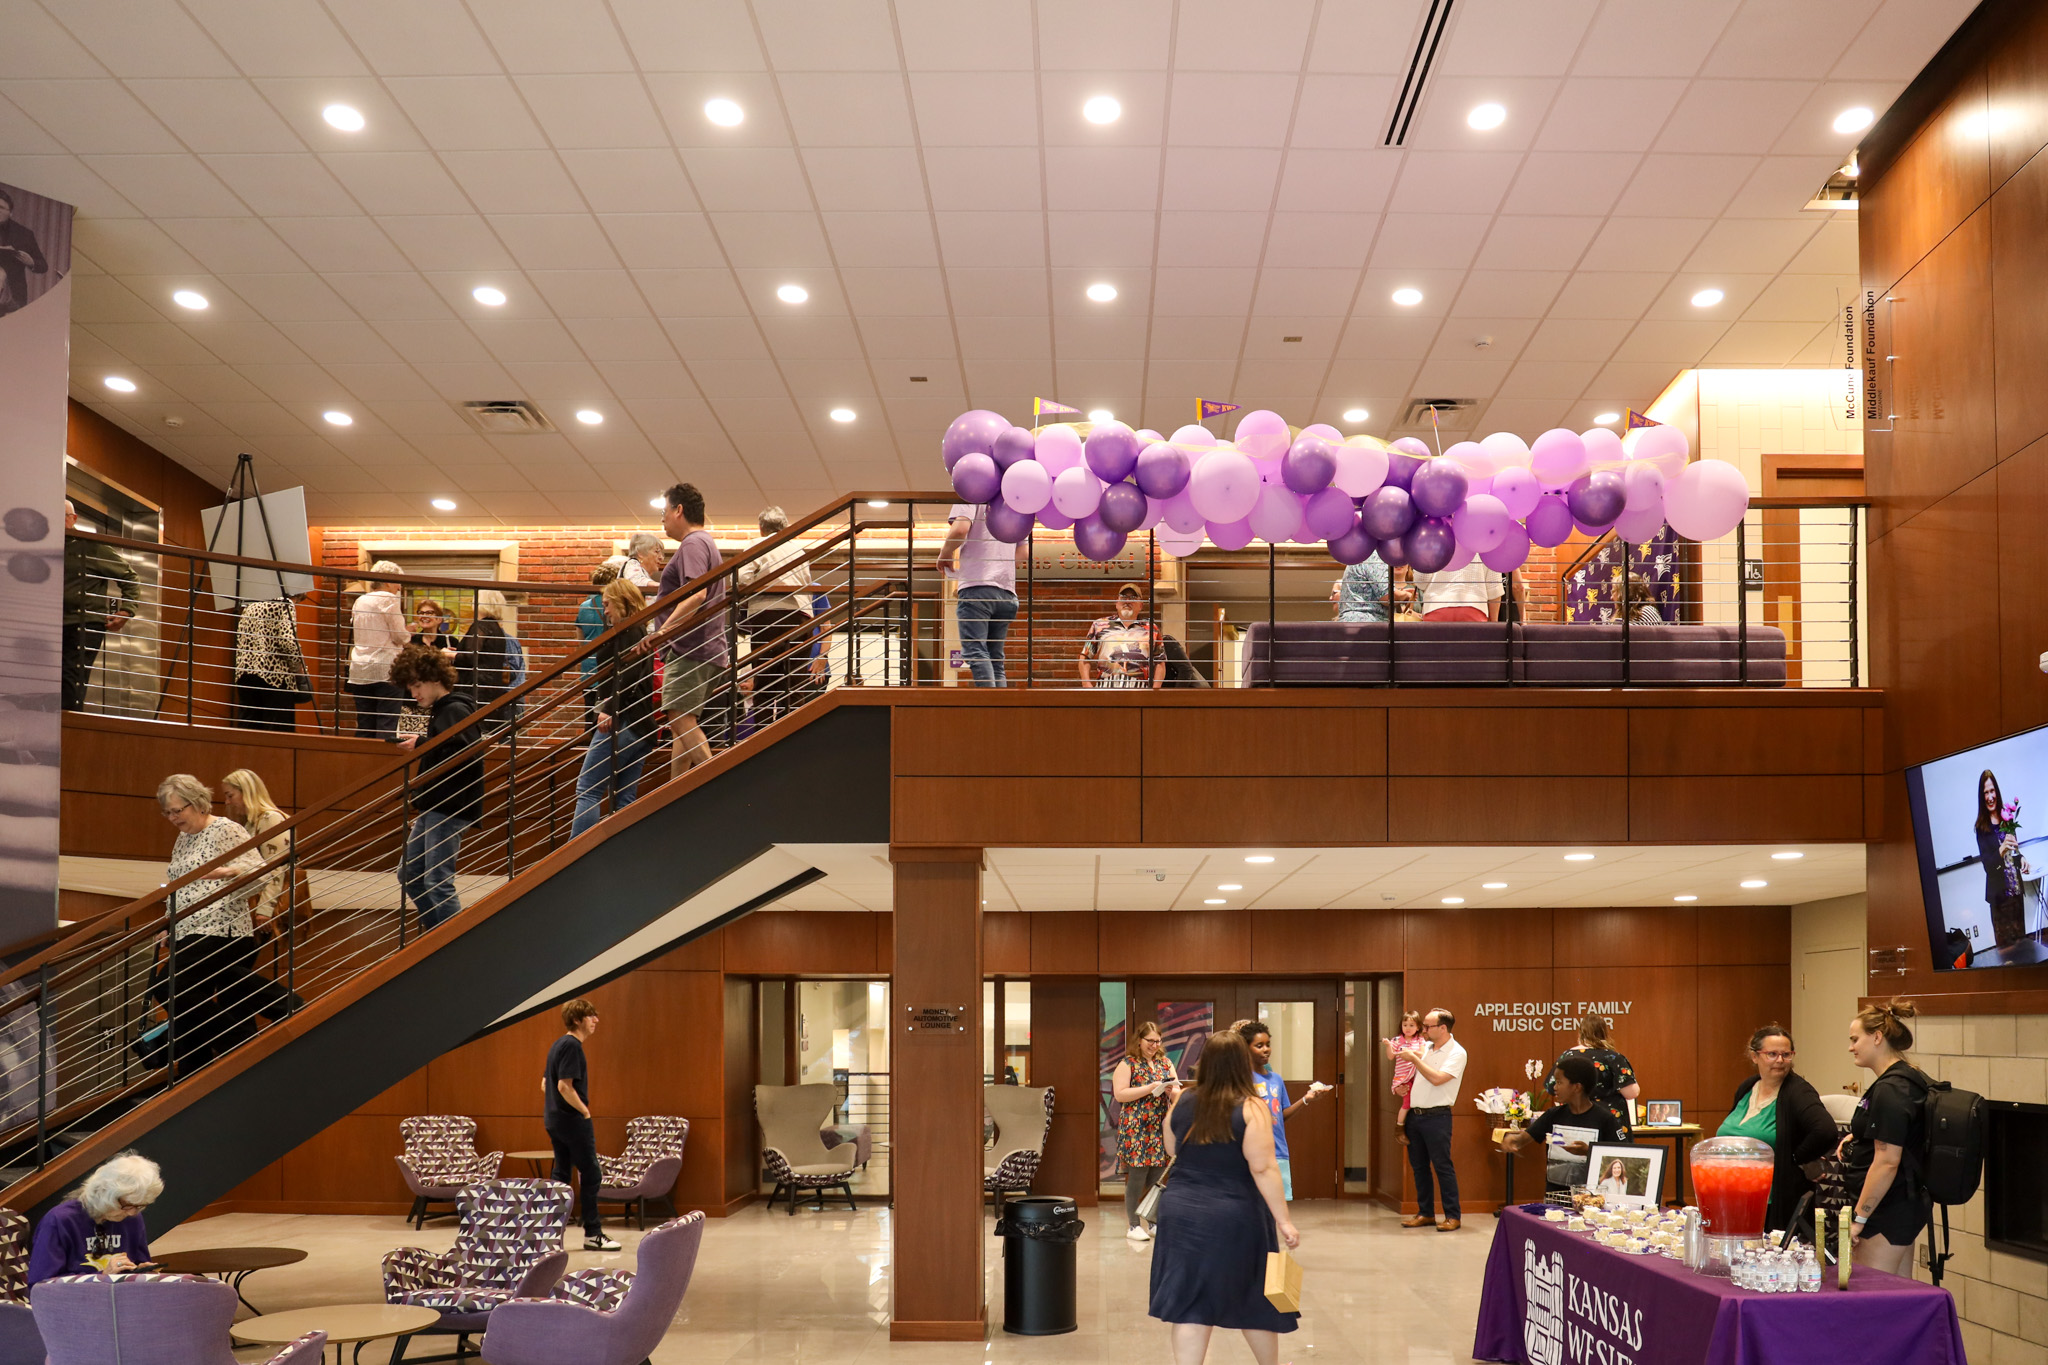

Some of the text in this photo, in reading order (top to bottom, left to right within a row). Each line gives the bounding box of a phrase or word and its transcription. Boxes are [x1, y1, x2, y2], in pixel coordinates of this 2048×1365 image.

[1845, 306, 1855, 419] McCune Foundation
[1866, 291, 1876, 419] Middlekauf Foundation
[1474, 1001, 1632, 1016] APPLEQUIST FAMILY
[1493, 1017, 1614, 1032] MUSIC CENR
[1567, 1320, 1633, 1365] WESL
[1568, 1273, 1643, 1352] KANSAS
